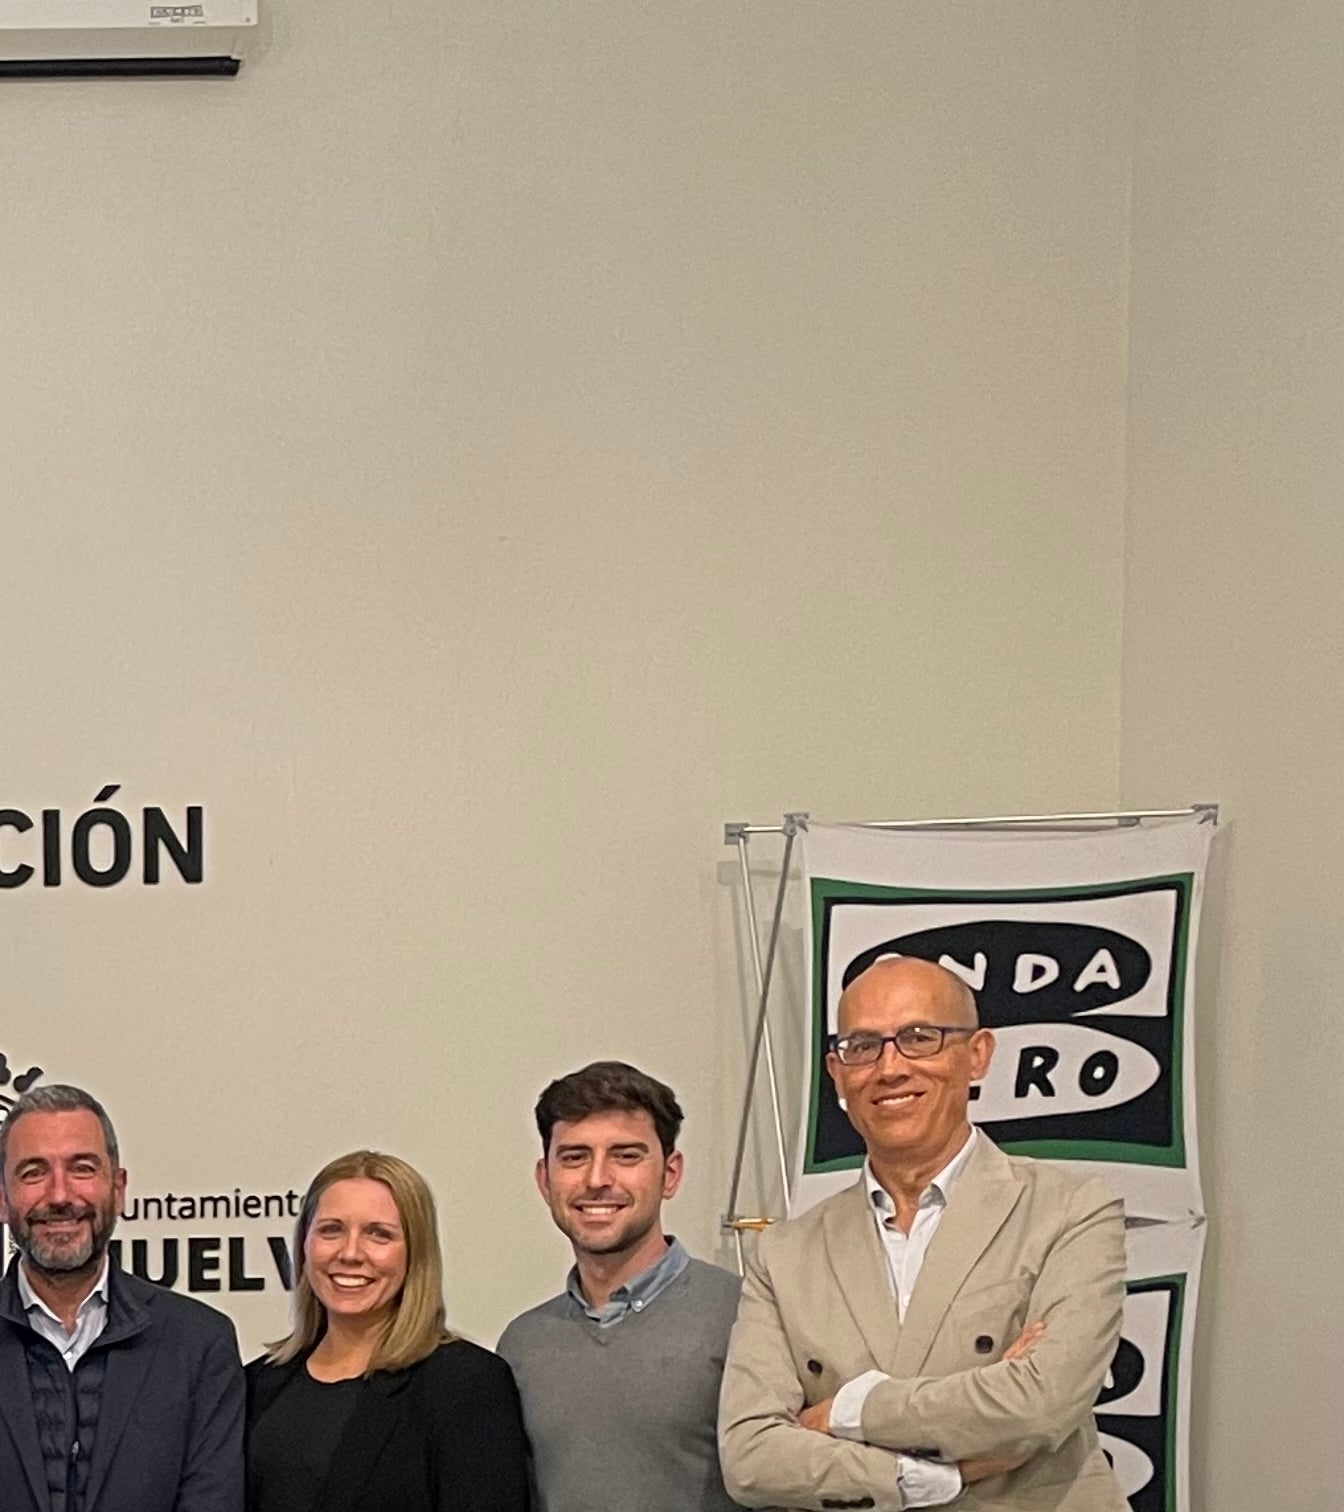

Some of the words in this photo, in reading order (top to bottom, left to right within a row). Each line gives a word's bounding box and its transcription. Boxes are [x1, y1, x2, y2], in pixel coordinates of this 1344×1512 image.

[874, 948, 1121, 994] NDA
[1014, 1045, 1119, 1099] RO
[121, 1187, 305, 1221] untamient
[109, 1236, 295, 1292] UELV
